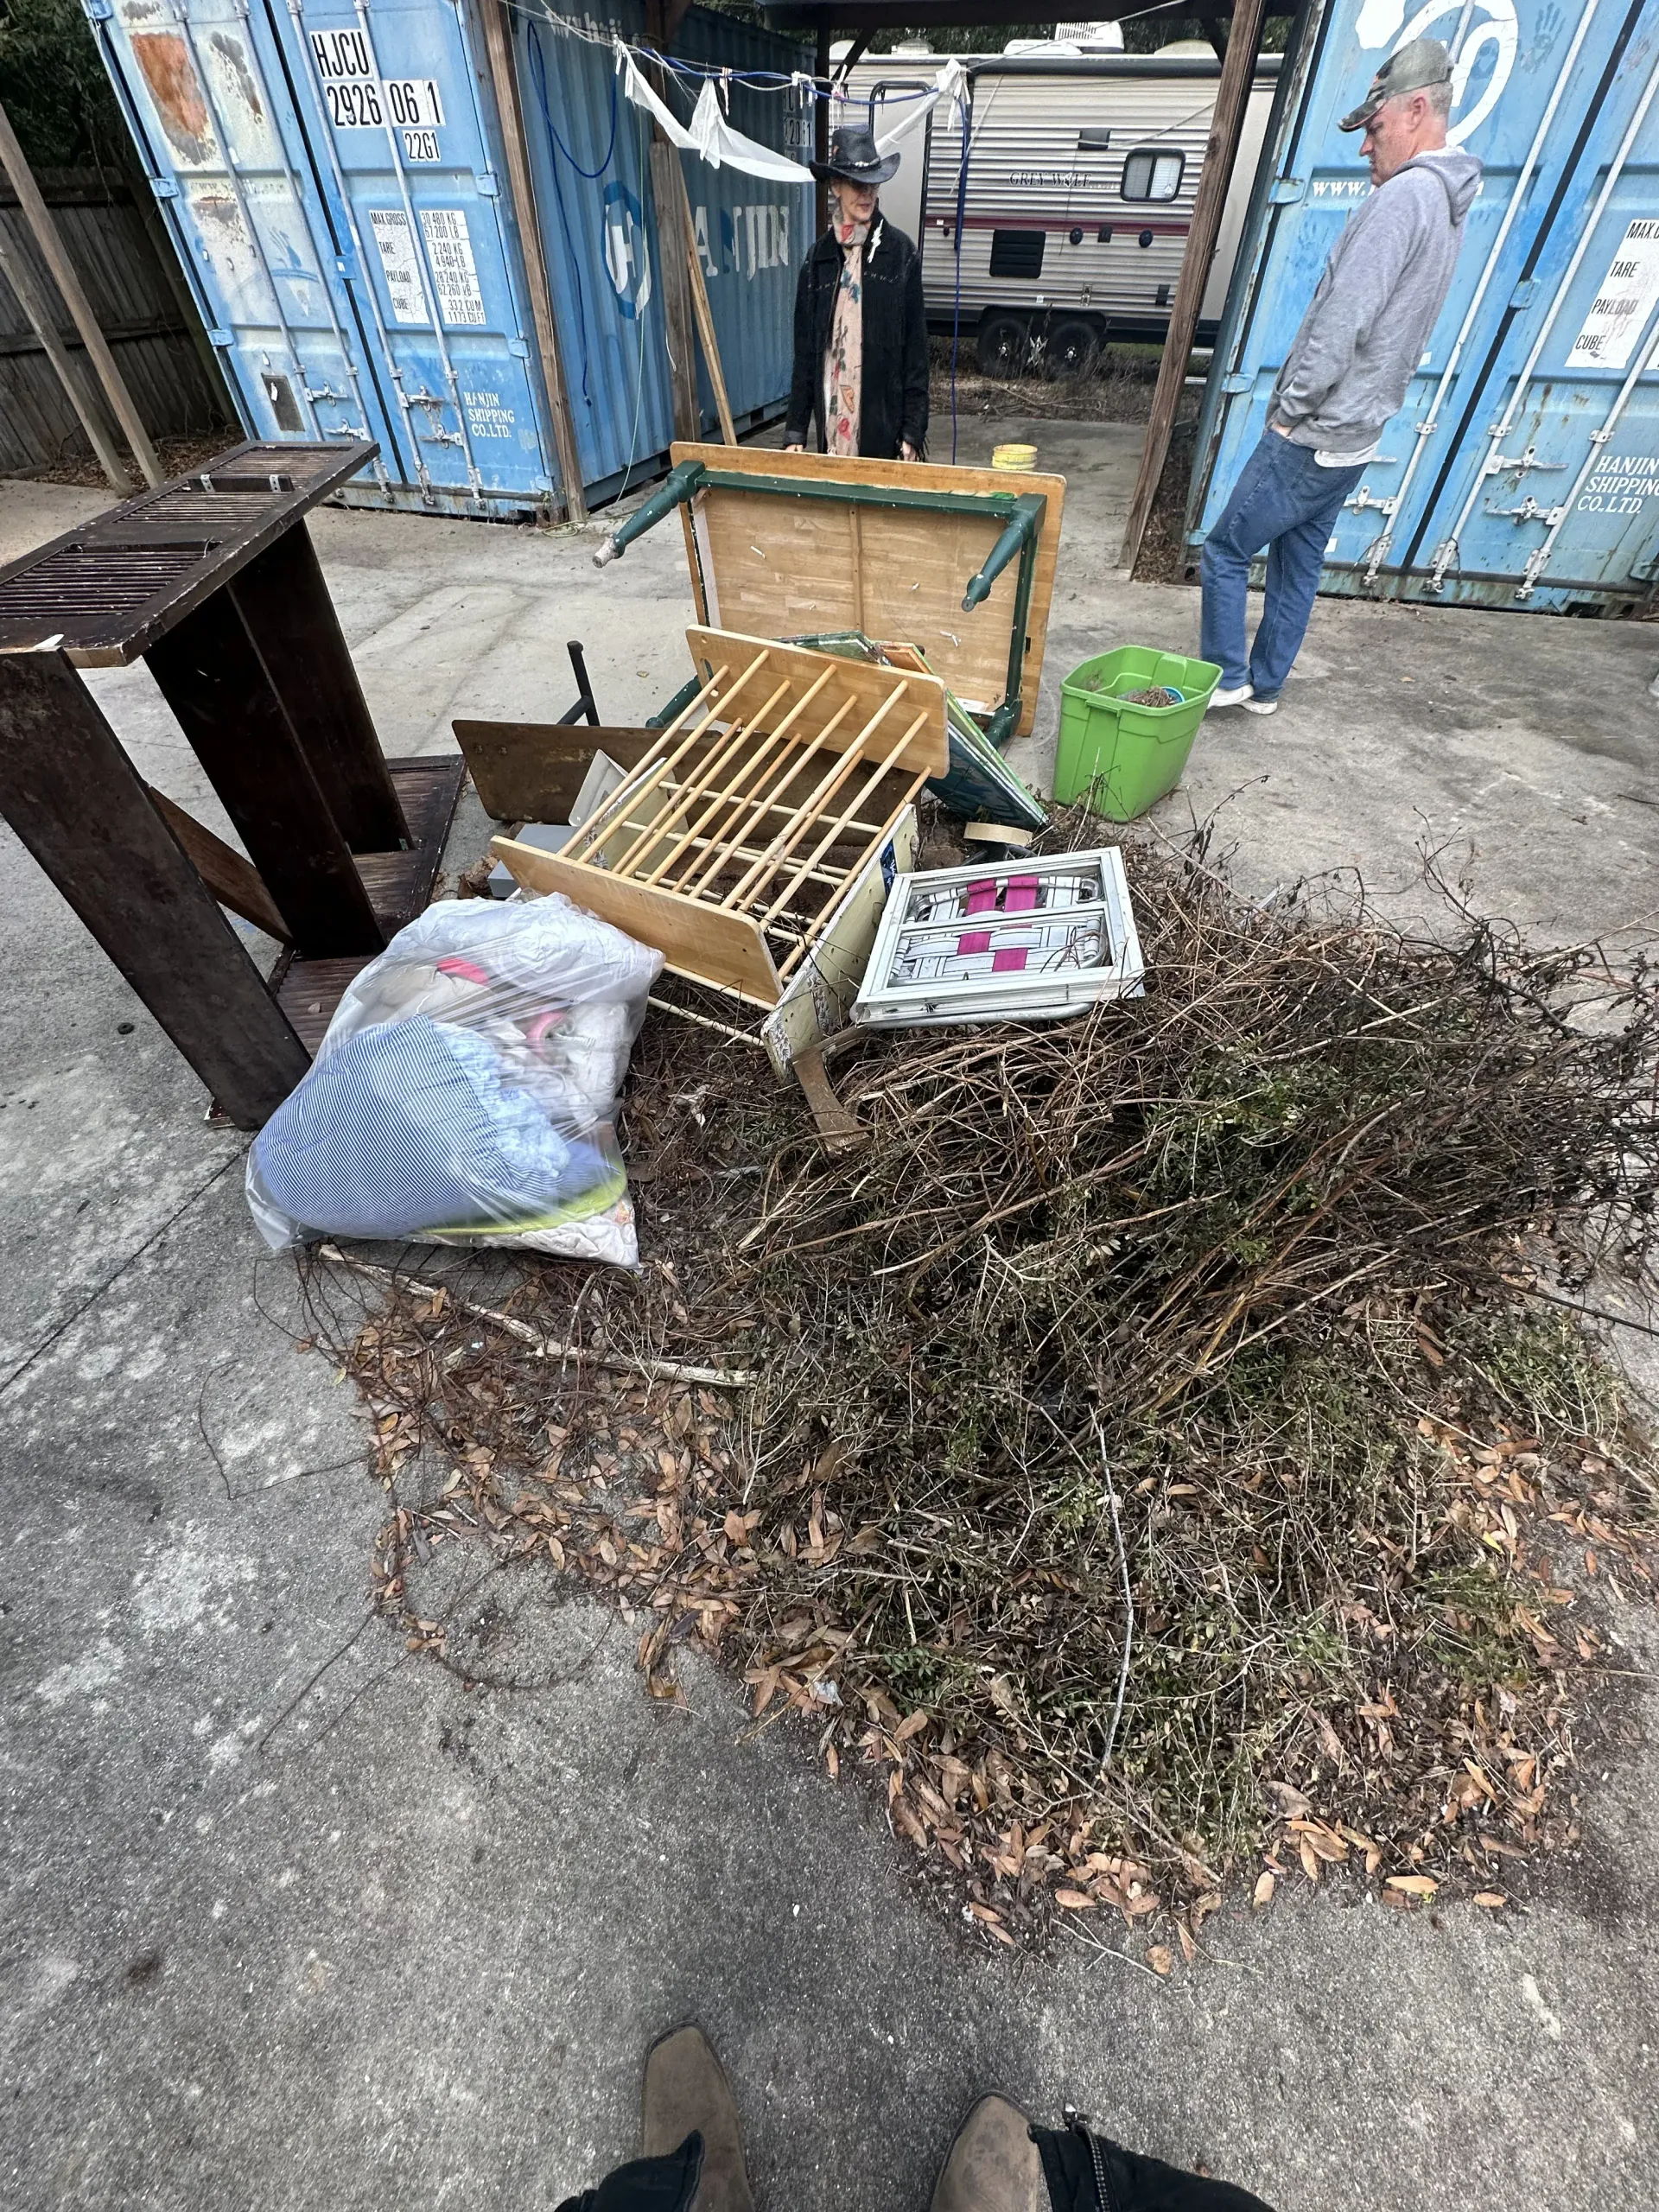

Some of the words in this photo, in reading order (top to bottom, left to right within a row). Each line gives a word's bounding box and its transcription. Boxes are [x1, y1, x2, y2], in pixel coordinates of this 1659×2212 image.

[311, 32, 370, 77] HJCU
[327, 84, 383, 126] 2926
[390, 83, 420, 124] 06
[428, 82, 441, 124] 1
[404, 132, 440, 159] 22G1
[1009, 172, 1044, 186] GREY
[447, 212, 457, 226] KG
[449, 226, 460, 239] LB
[378, 242, 396, 254] TARE
[453, 243, 463, 255] KG
[695, 205, 790, 282] ANJIN
[386, 270, 410, 283] PAYLOAD
[1610, 261, 1640, 277] TARE
[392, 298, 410, 309] CUBE
[1591, 299, 1639, 315] PAYLOAD
[1575, 335, 1606, 350] CUBE
[468, 408, 515, 423] SHIPPING
[1594, 455, 1659, 475] HANJIN
